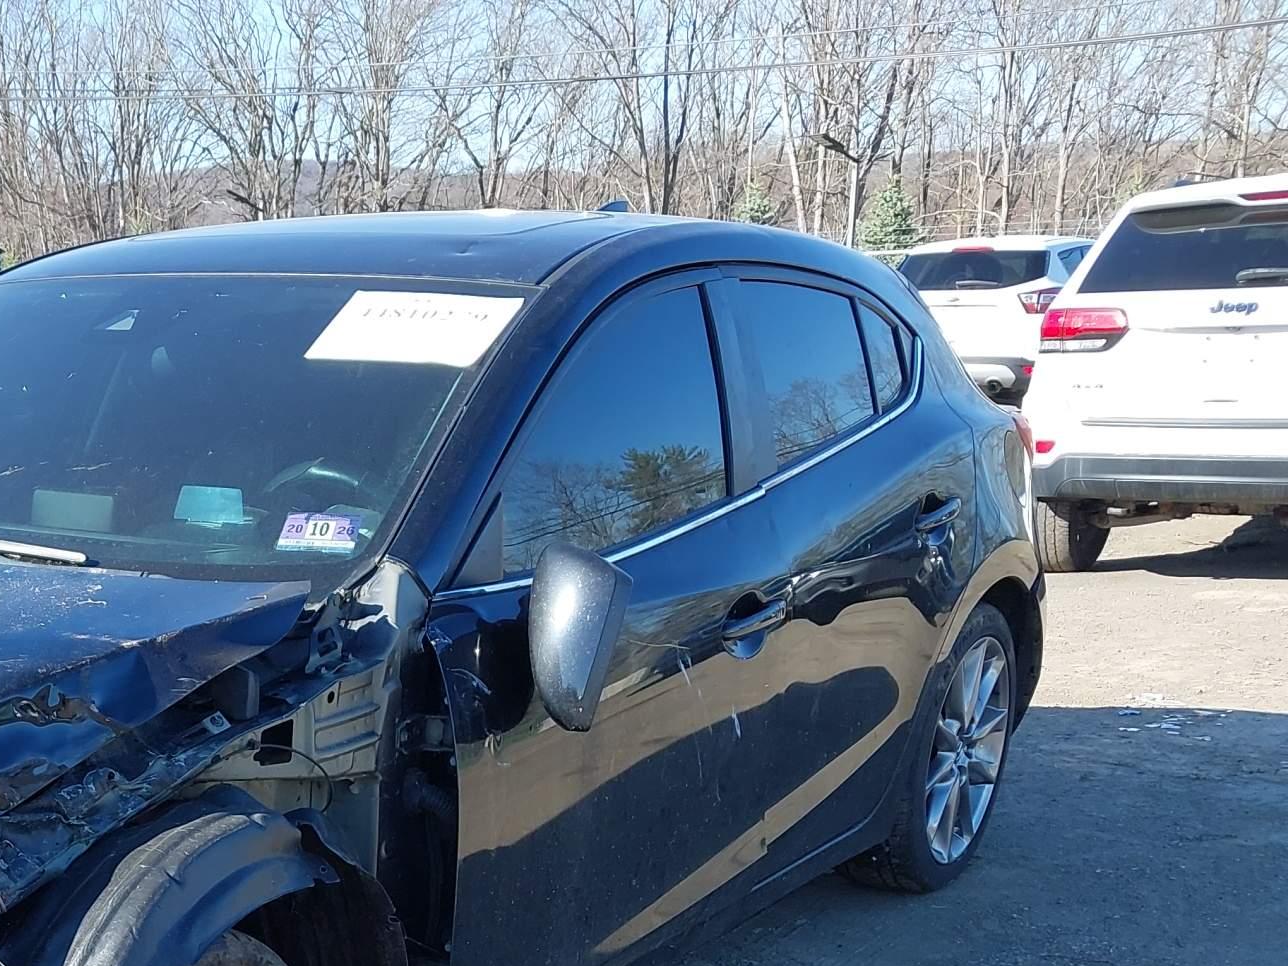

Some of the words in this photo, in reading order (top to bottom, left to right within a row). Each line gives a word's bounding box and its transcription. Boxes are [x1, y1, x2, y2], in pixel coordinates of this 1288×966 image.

[1210, 300, 1258, 315] Jeep
[287, 524, 303, 533] 20
[309, 522, 330, 536] 10
[336, 526, 355, 536] 26
